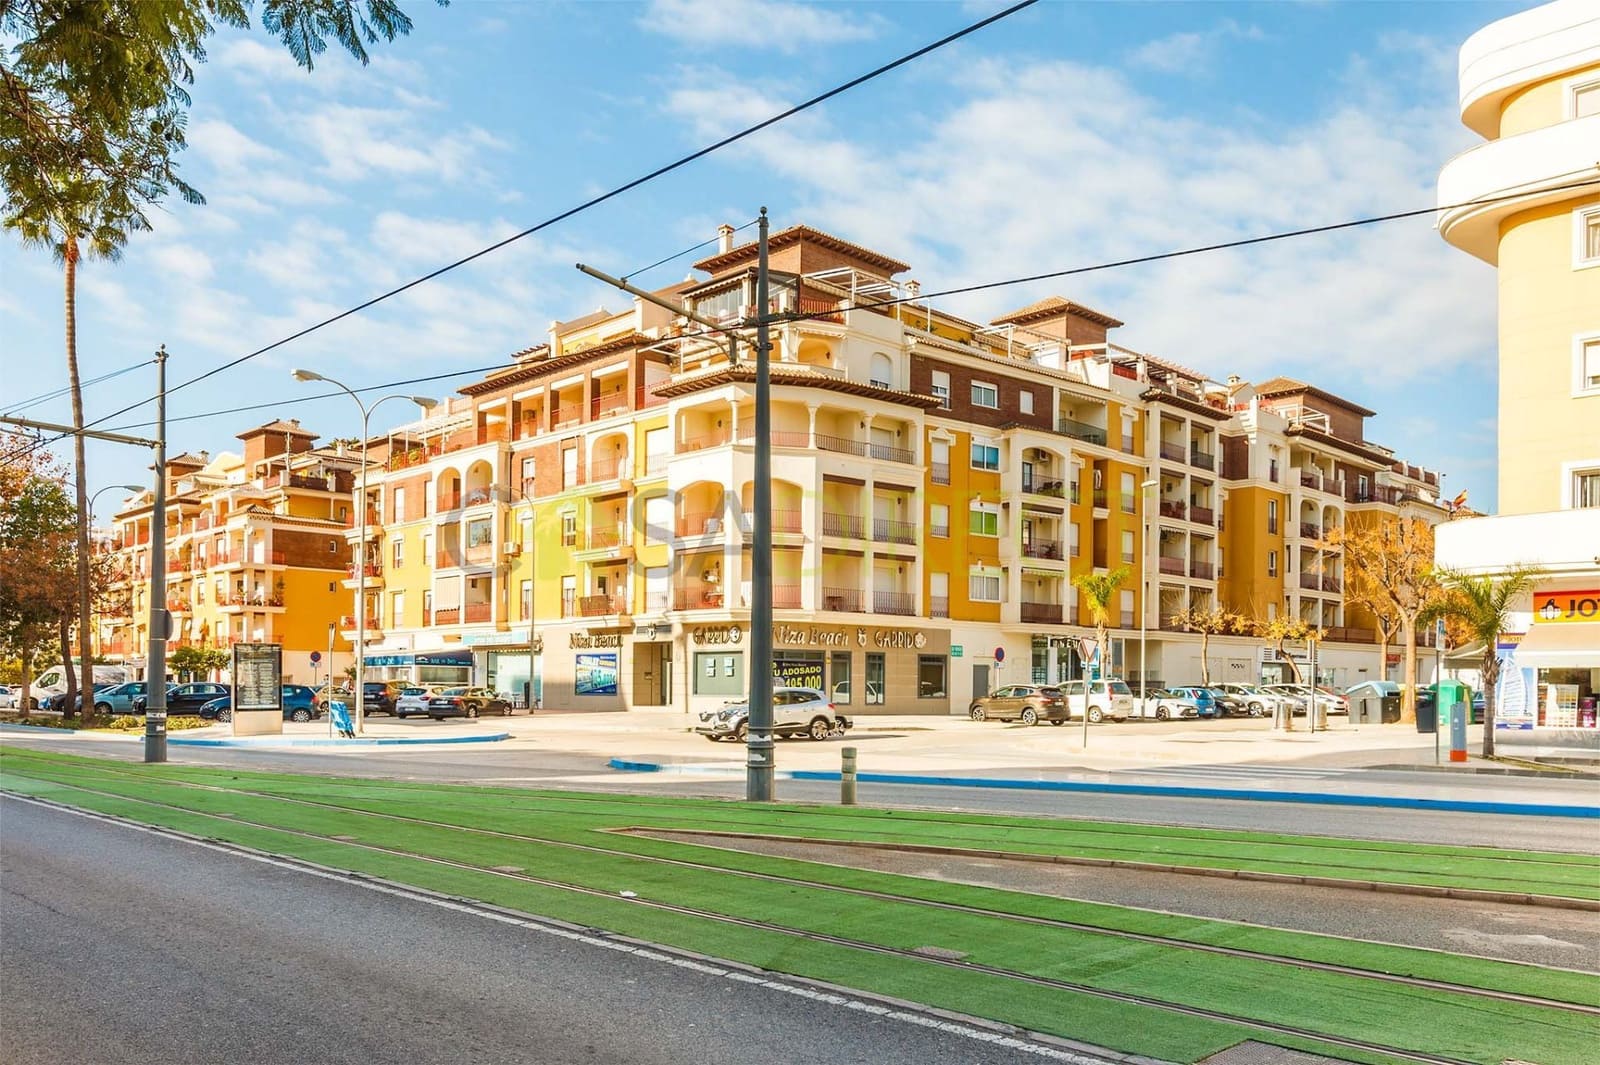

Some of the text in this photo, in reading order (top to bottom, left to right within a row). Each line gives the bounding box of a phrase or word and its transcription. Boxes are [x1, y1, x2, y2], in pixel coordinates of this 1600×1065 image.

[1565, 598, 1600, 618] JO
[808, 626, 849, 647] Beach
[782, 666, 822, 676] ADOSADO
